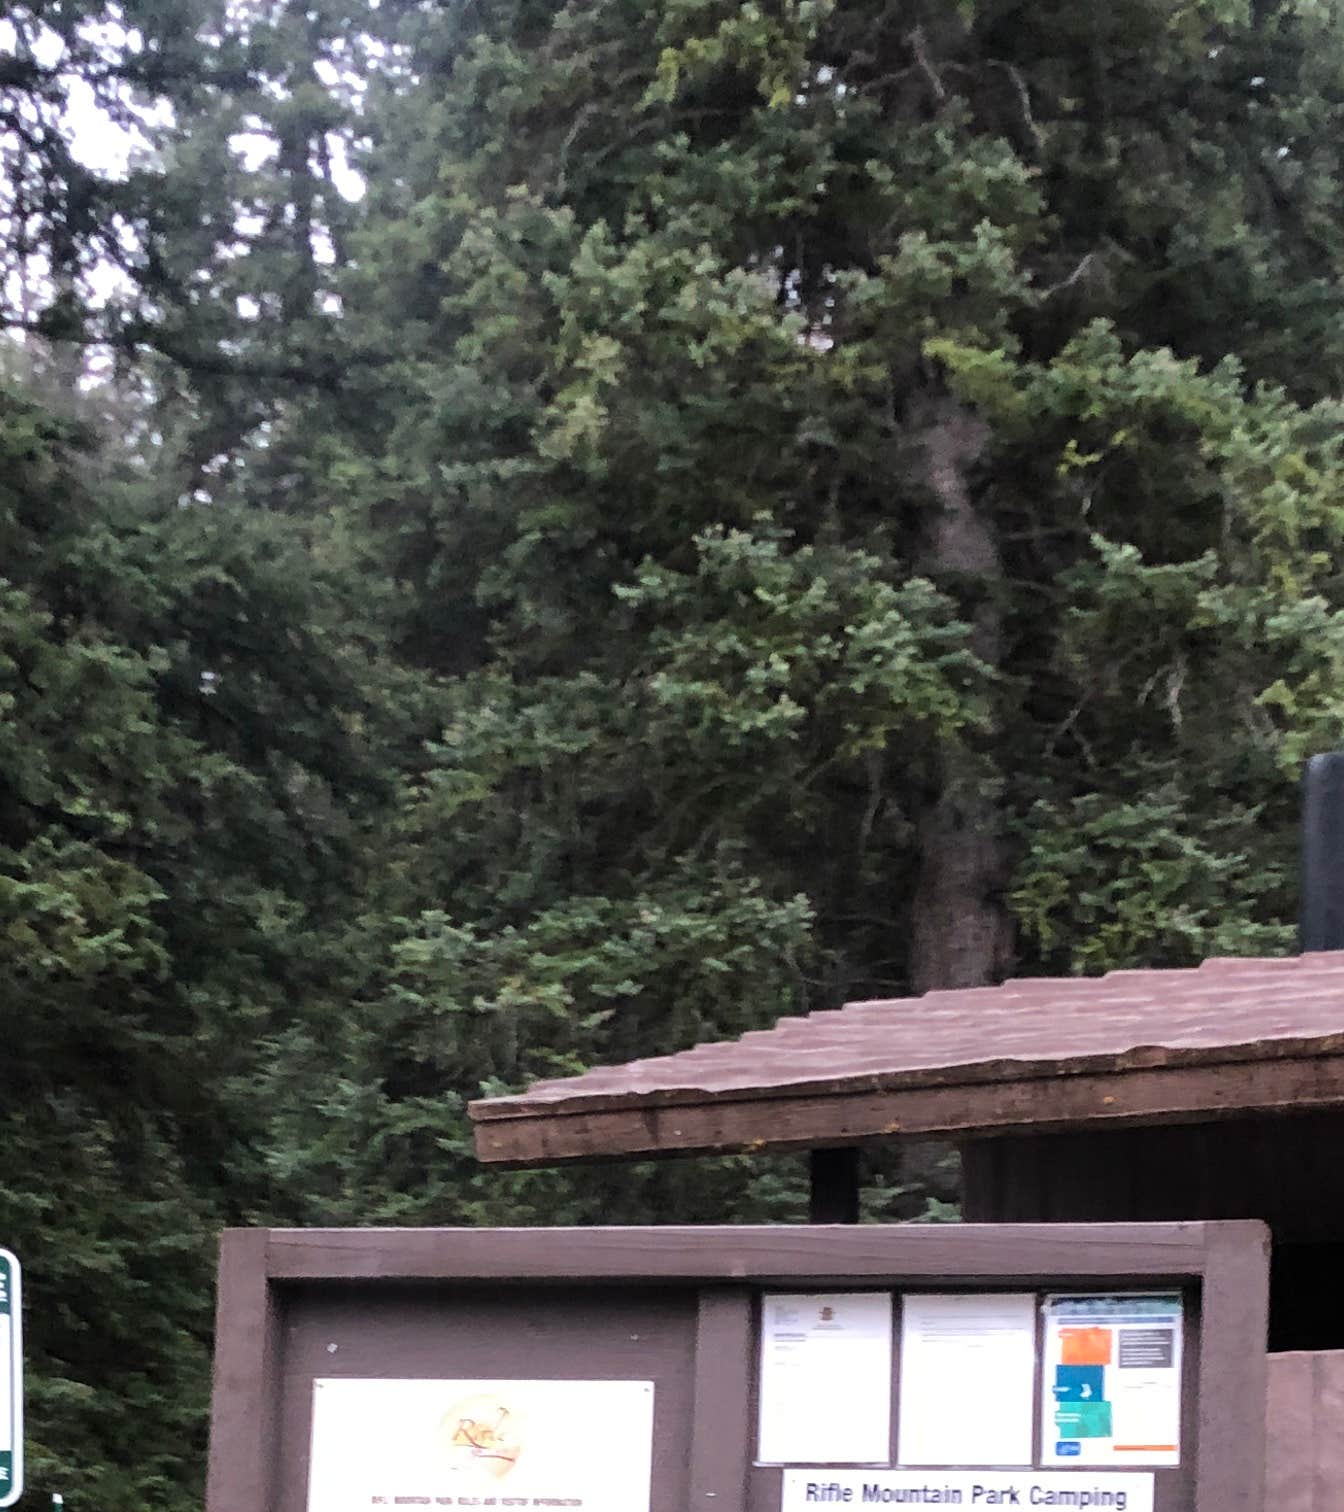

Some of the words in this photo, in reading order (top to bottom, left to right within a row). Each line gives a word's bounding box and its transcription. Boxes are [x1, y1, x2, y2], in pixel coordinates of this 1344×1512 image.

[806, 1482, 853, 1502] Rifle
[862, 1483, 962, 1504] Mountain
[972, 1485, 1020, 1504] Park
[1030, 1485, 1128, 1511] Camping
